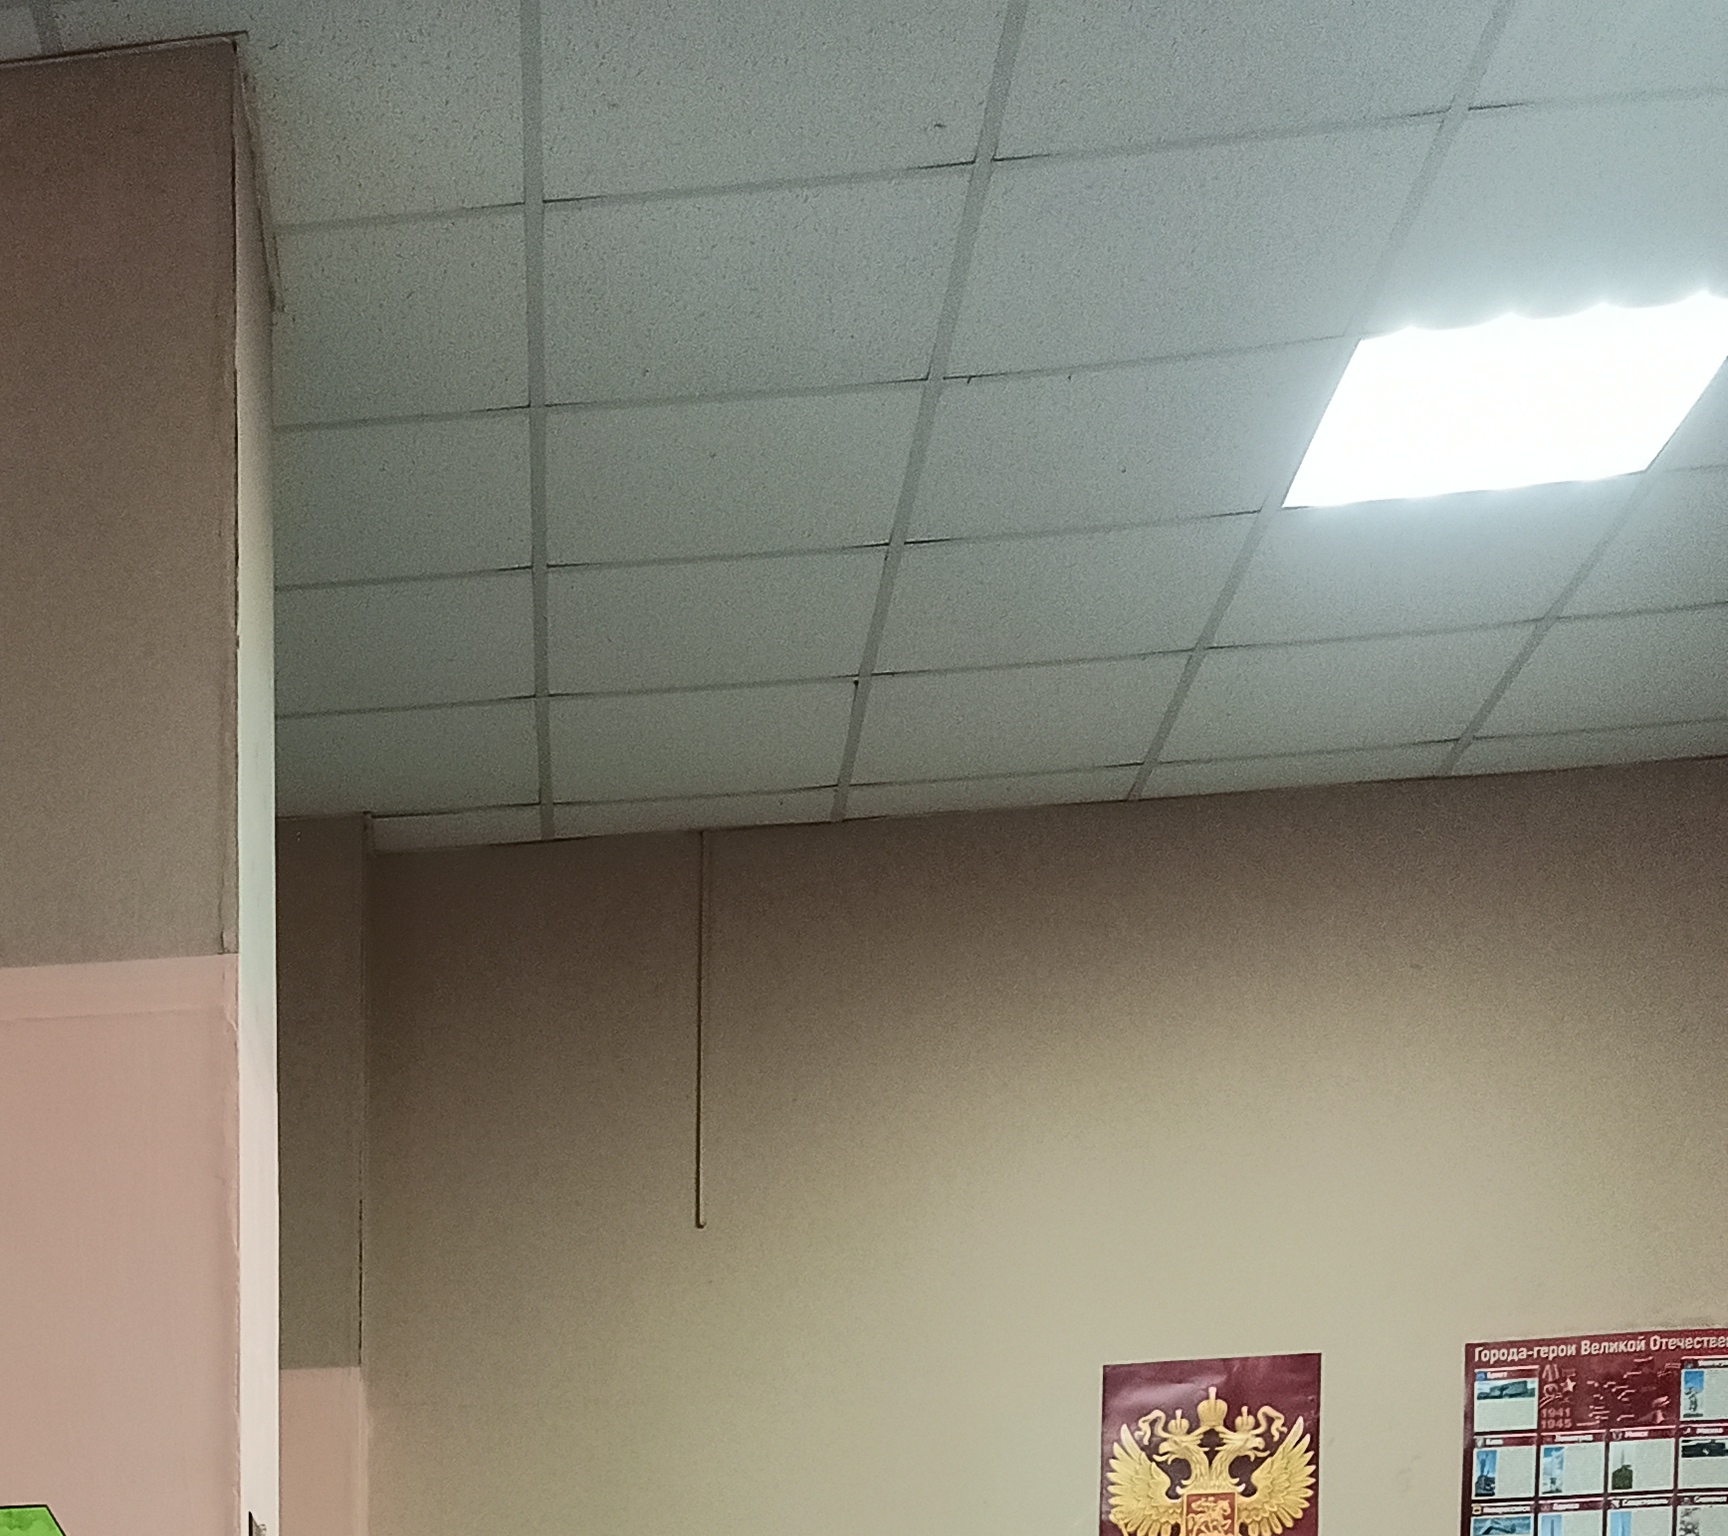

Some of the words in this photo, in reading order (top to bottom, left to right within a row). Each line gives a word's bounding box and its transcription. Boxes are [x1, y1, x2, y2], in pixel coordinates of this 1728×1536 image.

[1474, 1339, 1576, 1364] Города-герои
[1580, 1336, 1646, 1356] Великой
[1649, 1334, 1728, 1351] Отечестве
